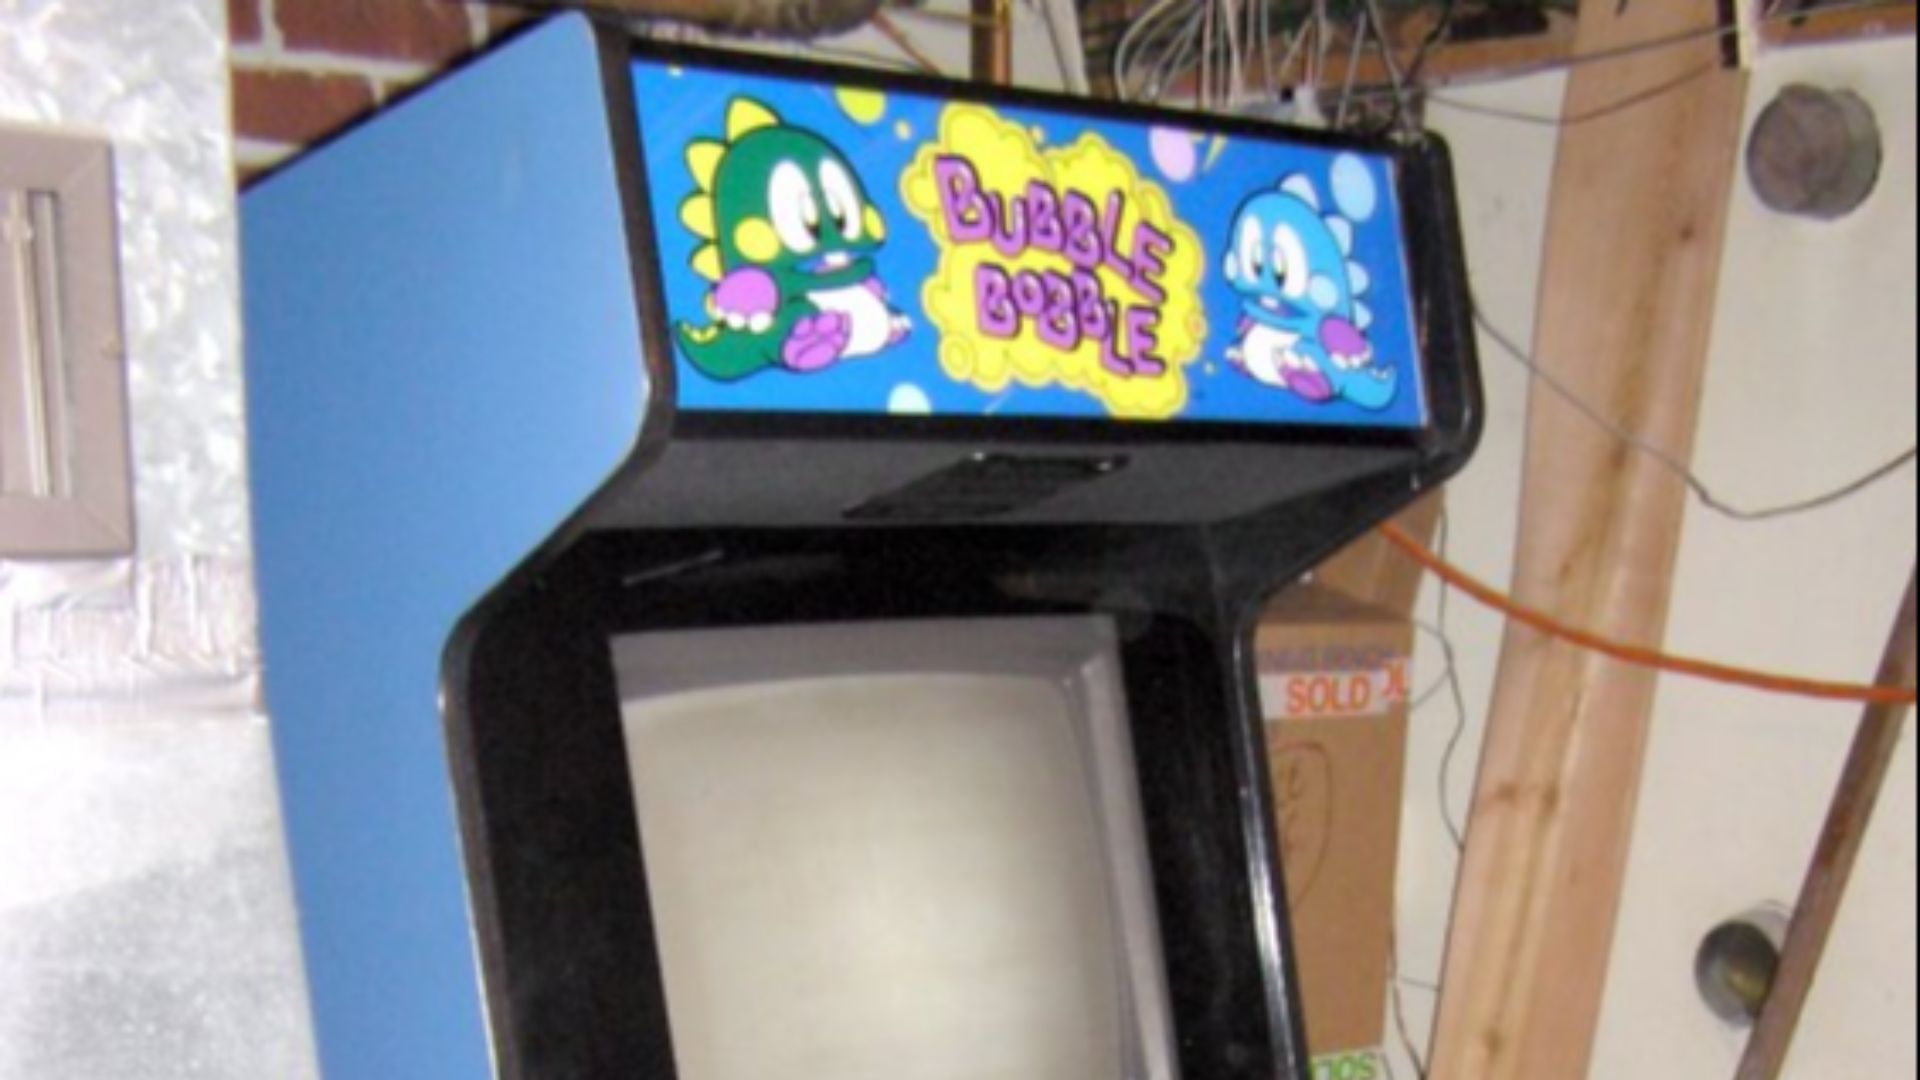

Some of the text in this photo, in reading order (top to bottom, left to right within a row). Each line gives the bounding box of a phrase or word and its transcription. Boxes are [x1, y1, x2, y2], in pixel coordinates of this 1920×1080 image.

[933, 153, 1175, 305] BUBBLE
[974, 261, 1168, 379] BOBBLE
[1286, 675, 1371, 715] SOLD
